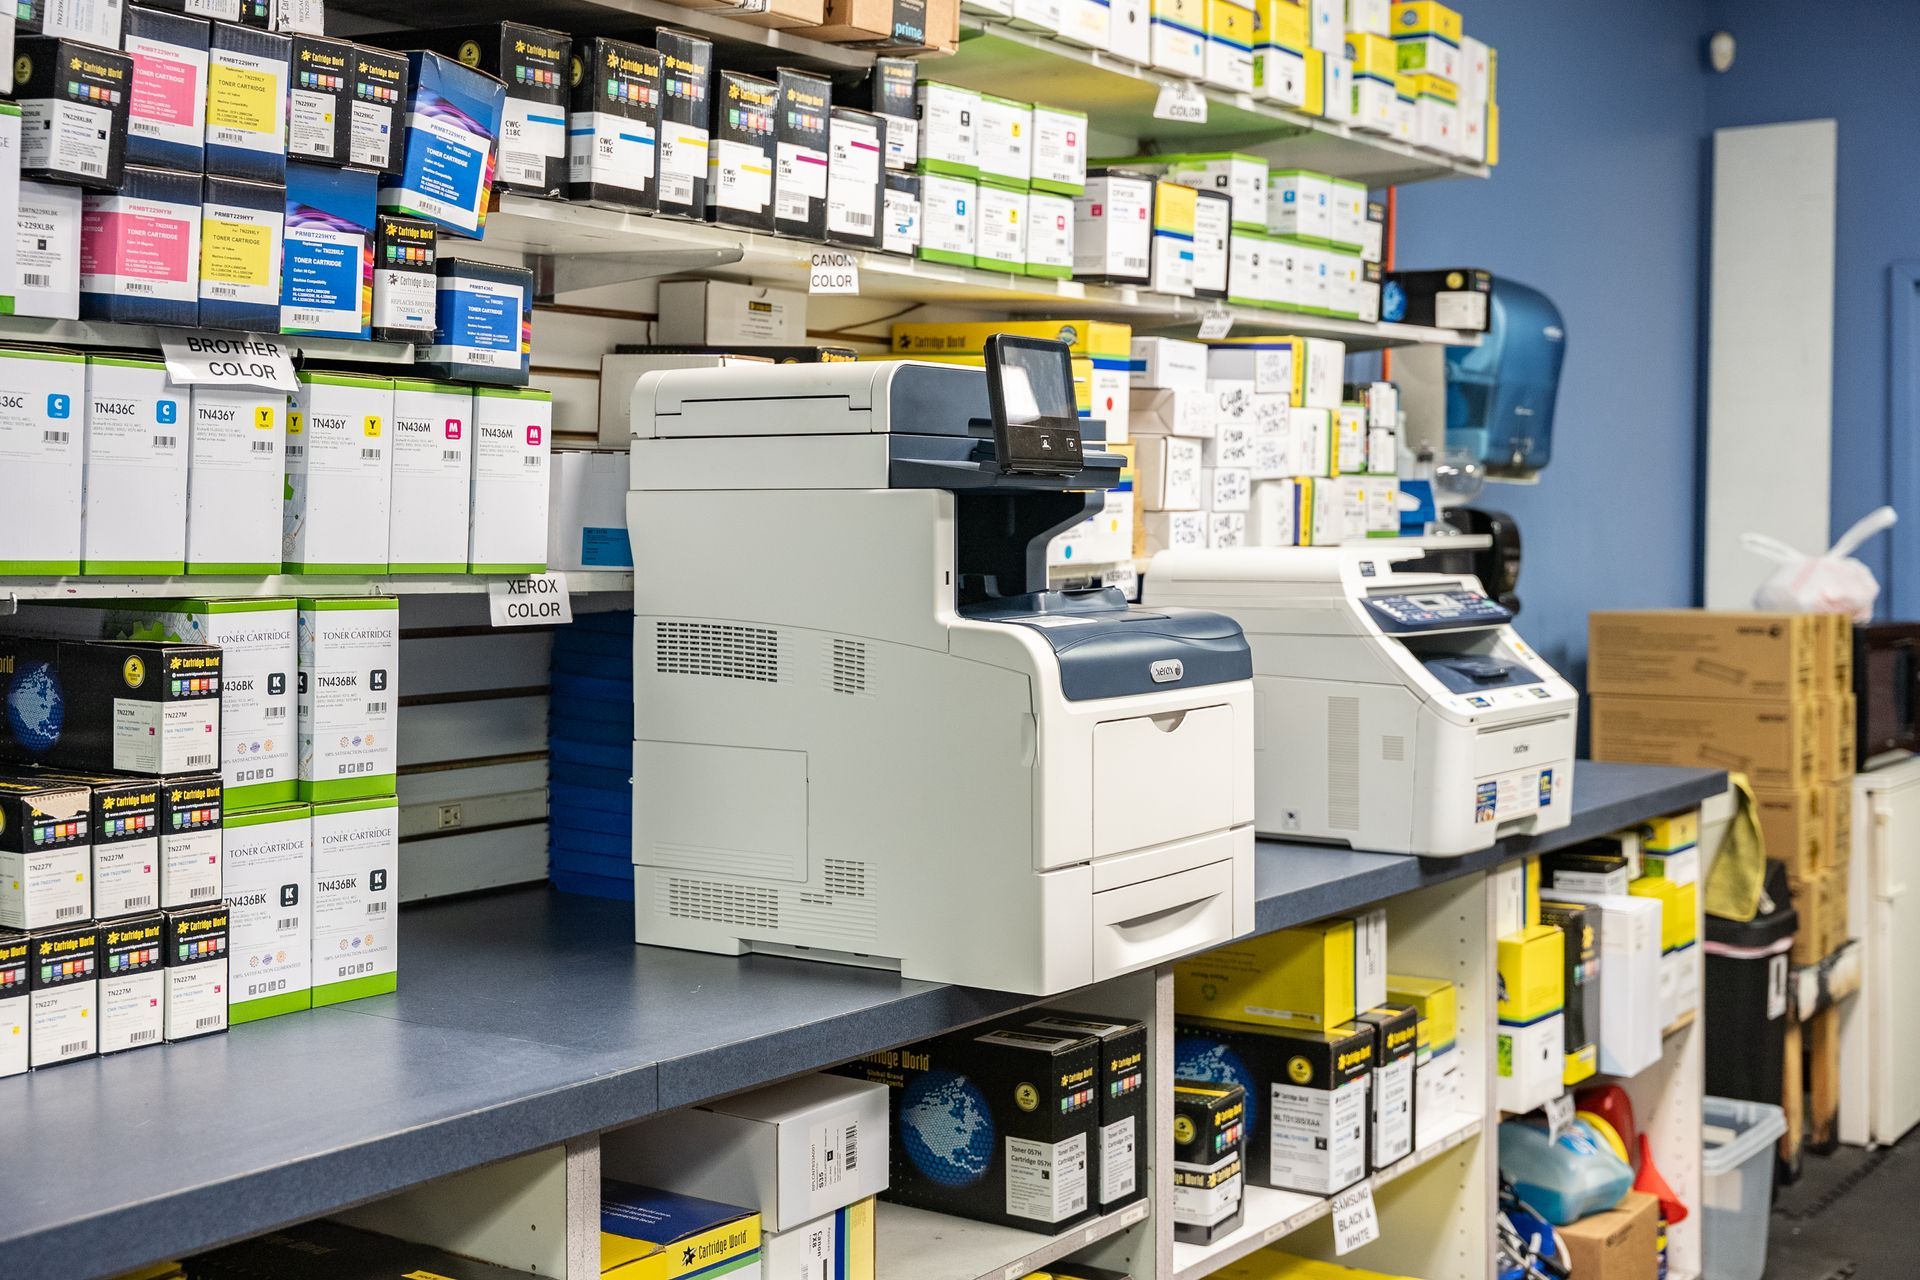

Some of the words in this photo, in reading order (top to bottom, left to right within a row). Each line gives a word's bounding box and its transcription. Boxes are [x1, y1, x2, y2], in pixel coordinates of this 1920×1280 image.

[895, 22, 923, 39] prime
[527, 44, 547, 58] Cartridge
[548, 49, 560, 60] World
[312, 53, 332, 66] Cartridge
[332, 57, 345, 67] World
[83, 62, 107, 77] Cartridge
[107, 67, 123, 80] World
[369, 66, 388, 77] Cartridge
[388, 70, 400, 80] World
[620, 58, 644, 75] Cartridge
[644, 63, 659, 78] World
[136, 68, 155, 78] TONER
[155, 72, 185, 84] CARTRIDGE
[237, 82, 266, 93] CARTRIDGE
[505, 120, 521, 128] CWC-
[505, 128, 521, 137] 118C
[600, 138, 614, 146] CWC-
[600, 146, 614, 154] 118C
[426, 148, 443, 158] TONER
[443, 153, 468, 168] CARTRIDGE
[723, 168, 736, 176] CWC-
[128, 228, 146, 236] TONER
[147, 231, 178, 240] CARTRIDGE
[398, 226, 419, 239] Cartridge
[420, 229, 434, 240] World
[232, 237, 260, 246] CARTRIDGE
[313, 259, 342, 268] CARTRIDGE
[401, 276, 422, 289] Cartridge
[812, 274, 853, 288] COLOR
[482, 308, 503, 316] CARTRIDGE
[187, 337, 281, 359] BROTHER
[914, 335, 944, 349] Cartridge
[946, 335, 965, 348] World
[208, 362, 277, 381] COLOR
[0, 396, 24, 409] 36C
[55, 398, 63, 410] C
[94, 402, 135, 416] TN436C
[162, 405, 170, 416] C
[199, 409, 235, 421] TN436Y
[261, 412, 269, 421] Y
[292, 417, 298, 426] Y
[312, 418, 346, 430] TN436Y
[370, 420, 376, 430] Y
[397, 422, 431, 432] TN436M
[449, 423, 459, 433] M
[481, 428, 513, 439] TN436M
[530, 429, 539, 438] M
[507, 579, 558, 595] XEROX
[508, 603, 561, 619] COLOR
[217, 634, 245, 644] TONER
[246, 631, 290, 642] CARTRIDGE
[323, 632, 350, 640] TONER
[351, 630, 392, 639] CARTRIDGE
[0, 656, 15, 674] orld
[183, 658, 205, 669] Cartridge
[206, 657, 220, 667] World
[1155, 665, 1174, 677] xerox
[273, 676, 281, 687] K
[318, 676, 357, 688] TN436BK
[374, 673, 383, 684] K
[222, 680, 254, 692] 436BK
[183, 790, 206, 800] Cartridge
[207, 787, 220, 798] World
[116, 796, 140, 807] Cartridge
[141, 793, 156, 803] World
[322, 834, 348, 845] TONER
[350, 828, 392, 841] CARTRIDGE
[167, 844, 191, 853] TN227M
[229, 848, 258, 859] TONER
[260, 840, 304, 855] CARTRIDGE
[100, 854, 124, 863] TN227M
[29, 864, 52, 872] TN227Y
[375, 873, 383, 884] K
[318, 878, 357, 892] TN436BK
[286, 889, 295, 899] K
[224, 894, 267, 907] TN436BK
[190, 920, 213, 932] Cartridge
[213, 916, 227, 928] World
[120, 930, 144, 942] Cartridge
[145, 926, 160, 938] World
[54, 940, 78, 952] Cartridge
[79, 936, 95, 948] World
[10, 945, 27, 958] World
[173, 975, 197, 984] TN227M
[108, 988, 132, 997] TN227M
[35, 1000, 58, 1009] TN227Y
[902, 1050, 929, 1072] World
[1108, 1131, 1118, 1139] Toner
[1108, 1138, 1125, 1149] Cartridge
[1011, 1146, 1027, 1154] Toner
[1027, 1148, 1042, 1157] 057H
[1058, 1148, 1069, 1156] Toner
[1011, 1155, 1036, 1166] Cartridge
[1037, 1160, 1052, 1168] 057H
[1058, 1155, 1076, 1166] Cartridge
[1332, 1187, 1368, 1214] SAMSUNG
[1338, 1210, 1365, 1232] BLACK
[1345, 1227, 1370, 1249] WHITE
[698, 1238, 728, 1260] Cartridge
[729, 1230, 748, 1249] World
